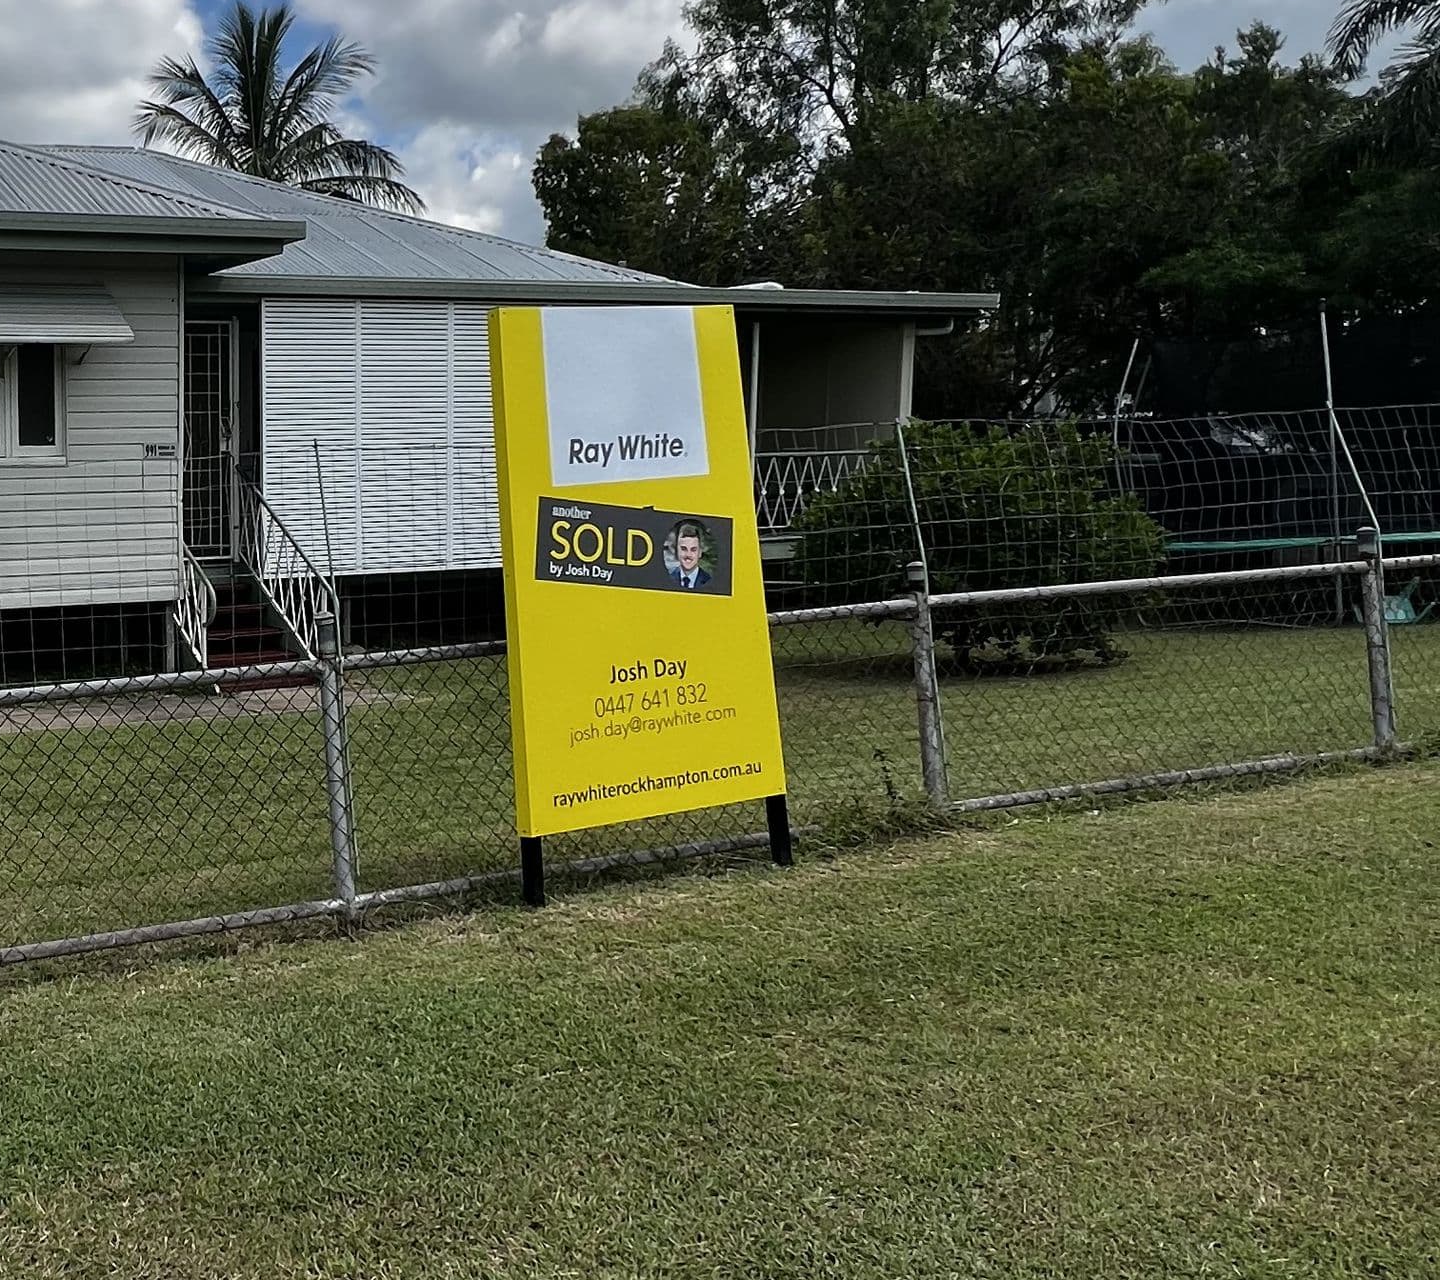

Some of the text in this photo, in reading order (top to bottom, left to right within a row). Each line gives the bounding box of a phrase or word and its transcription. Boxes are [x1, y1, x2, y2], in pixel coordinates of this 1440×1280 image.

[146, 444, 156, 456] 991
[569, 433, 684, 467] Ray White
[552, 505, 592, 520] another
[550, 520, 653, 567] SOLD
[549, 561, 613, 582] by Josh Day
[610, 659, 687, 684] Josh Day
[594, 683, 708, 718] 0447 641 832
[553, 761, 762, 807] raywhiterockhampton.com.au
